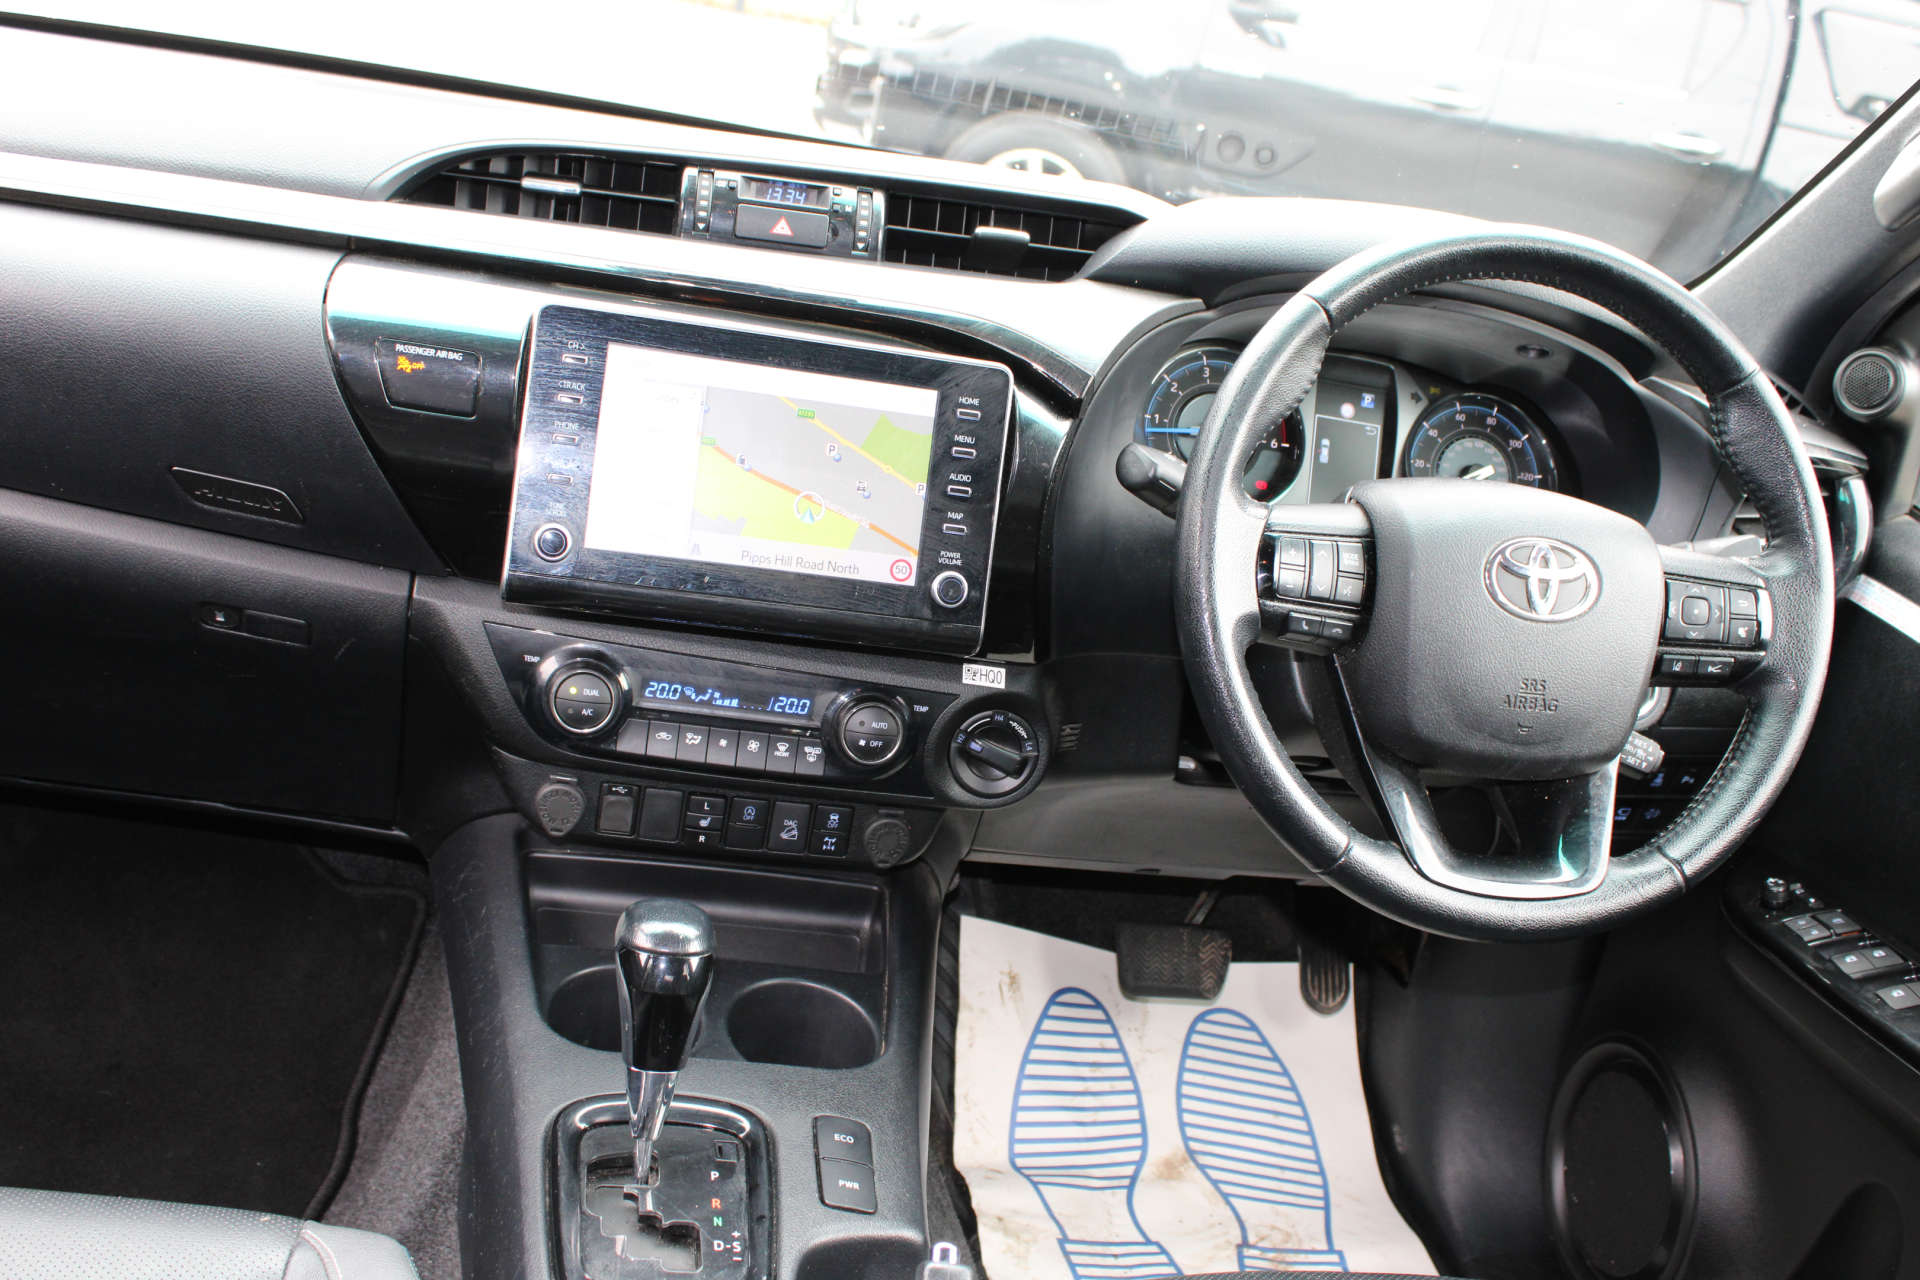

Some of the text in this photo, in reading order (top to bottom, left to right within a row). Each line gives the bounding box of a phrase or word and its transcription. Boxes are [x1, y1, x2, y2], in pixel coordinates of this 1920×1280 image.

[394, 343, 436, 357] PASSENGER
[1202, 367, 1210, 378] 3
[1170, 382, 1178, 393] 2
[958, 396, 980, 406] HOME
[1154, 414, 1160, 424] 1
[1455, 413, 1466, 422] 60
[1486, 416, 1497, 426] 80
[553, 420, 580, 431] PHONE
[1427, 428, 1438, 438] 40
[954, 434, 976, 444] MENU
[1270, 438, 1278, 449] 6
[1508, 439, 1523, 449] 100
[1414, 458, 1425, 468] 20
[949, 472, 972, 482] AUDIO
[947, 511, 964, 520] MAP
[939, 550, 962, 559] POWER
[741, 550, 860, 576] Pipps Hill Road North
[938, 557, 963, 566] VOLUME
[895, 564, 908, 576] 50
[522, 654, 540, 663] TEMP
[1519, 679, 1547, 692] SRS
[583, 687, 600, 697] DUAL
[644, 681, 682, 701] 20.0
[773, 695, 811, 715] 20.0
[1502, 694, 1560, 712] AIRBAG
[581, 707, 594, 716] A/C
[913, 704, 929, 713] TEMP
[871, 720, 888, 730] AUTO
[869, 739, 884, 748] OFF
[703, 801, 710, 810] L
[783, 819, 799, 827] DAC
[827, 820, 839, 828] OFF
[698, 835, 706, 843] R
[833, 1133, 855, 1145] ECO
[710, 1171, 720, 1181] P
[838, 1179, 860, 1191] PWR
[711, 1198, 722, 1209] R
[713, 1216, 723, 1227] N
